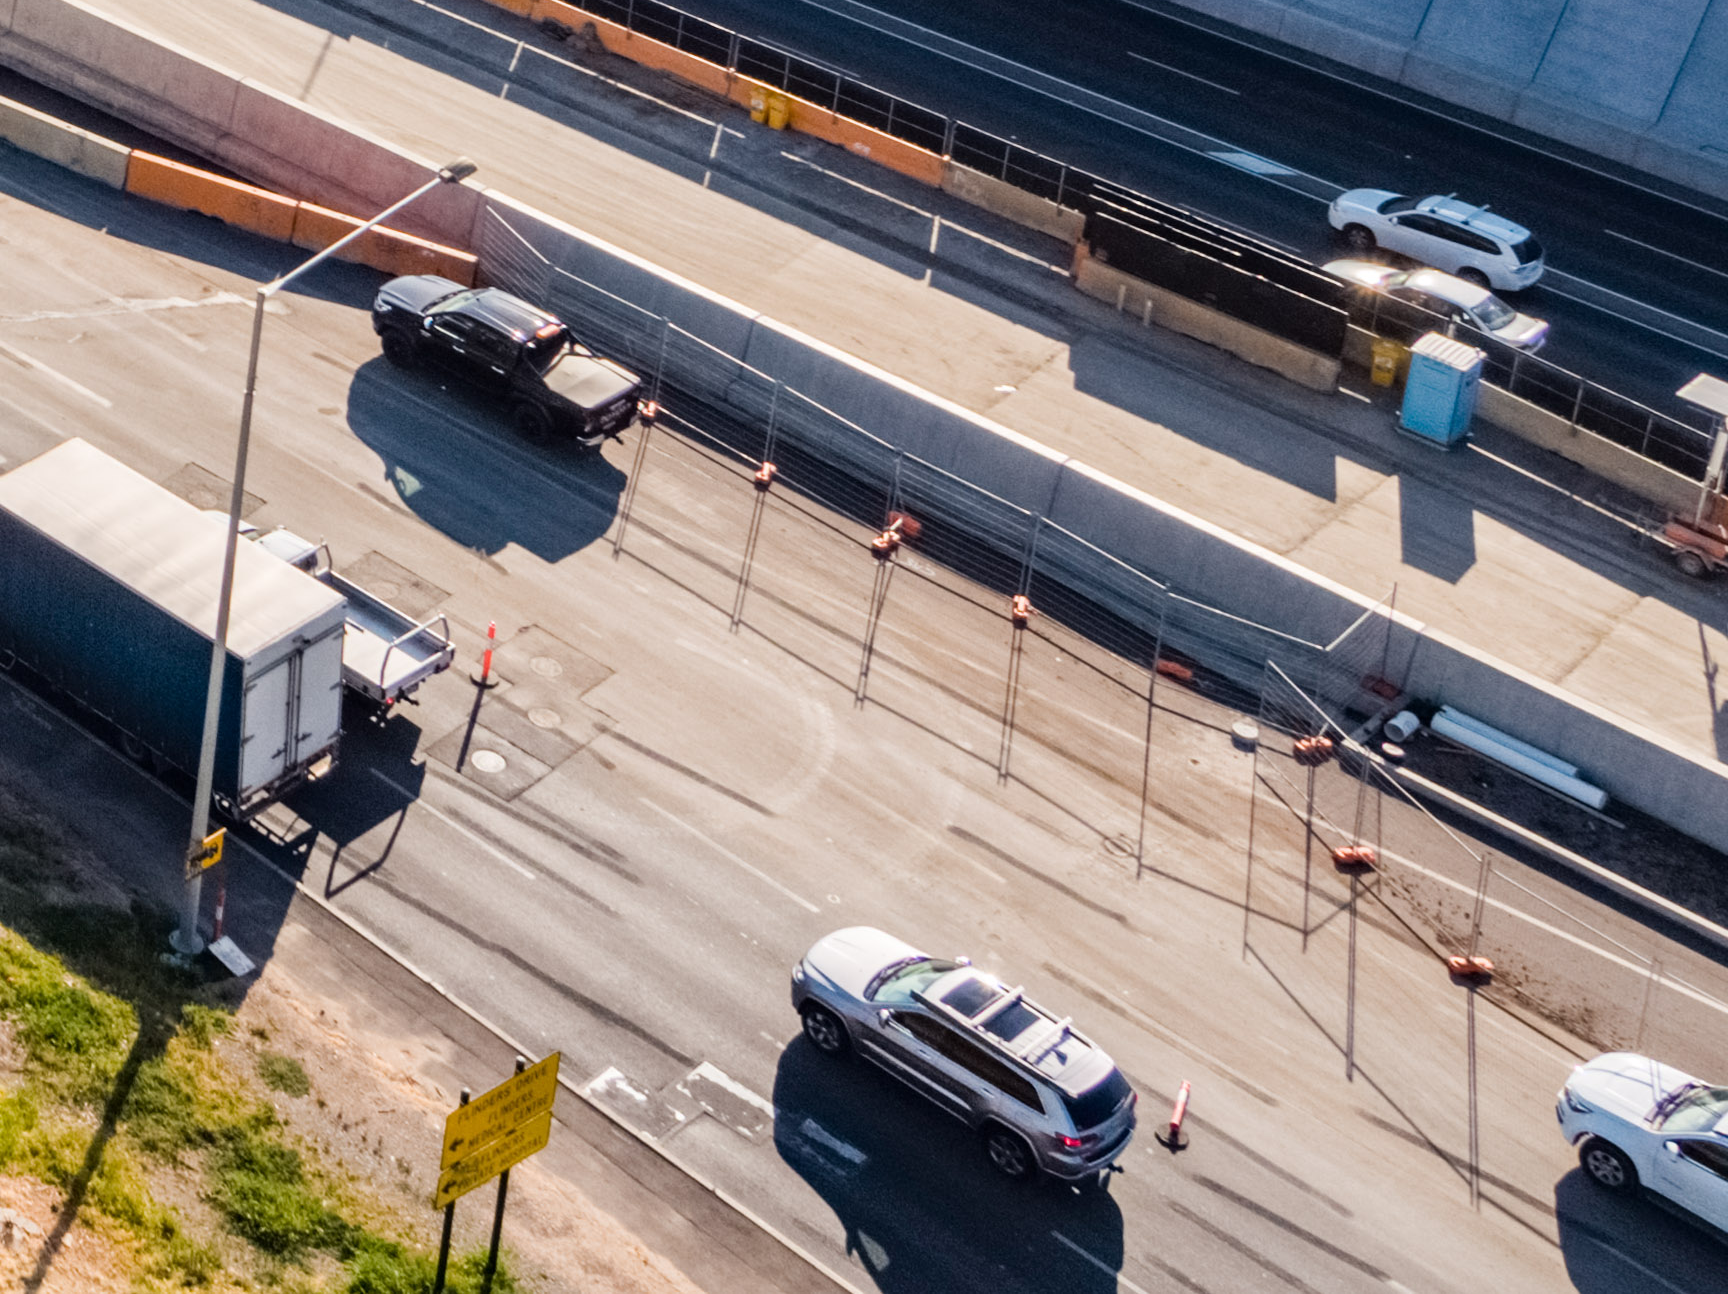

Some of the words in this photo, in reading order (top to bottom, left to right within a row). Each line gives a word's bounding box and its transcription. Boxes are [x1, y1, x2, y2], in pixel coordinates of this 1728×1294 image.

[457, 1085, 512, 1125] FLINDERS
[514, 1065, 548, 1092] DRIVE
[467, 1121, 508, 1151] MEDICAL
[512, 1093, 550, 1124] CENTRE
[487, 1088, 534, 1123] FLINDERS
[456, 1162, 495, 1192] PRIVATE
[499, 1134, 543, 1166] HOSPITAL
[480, 1130, 526, 1164] FLINDERS
